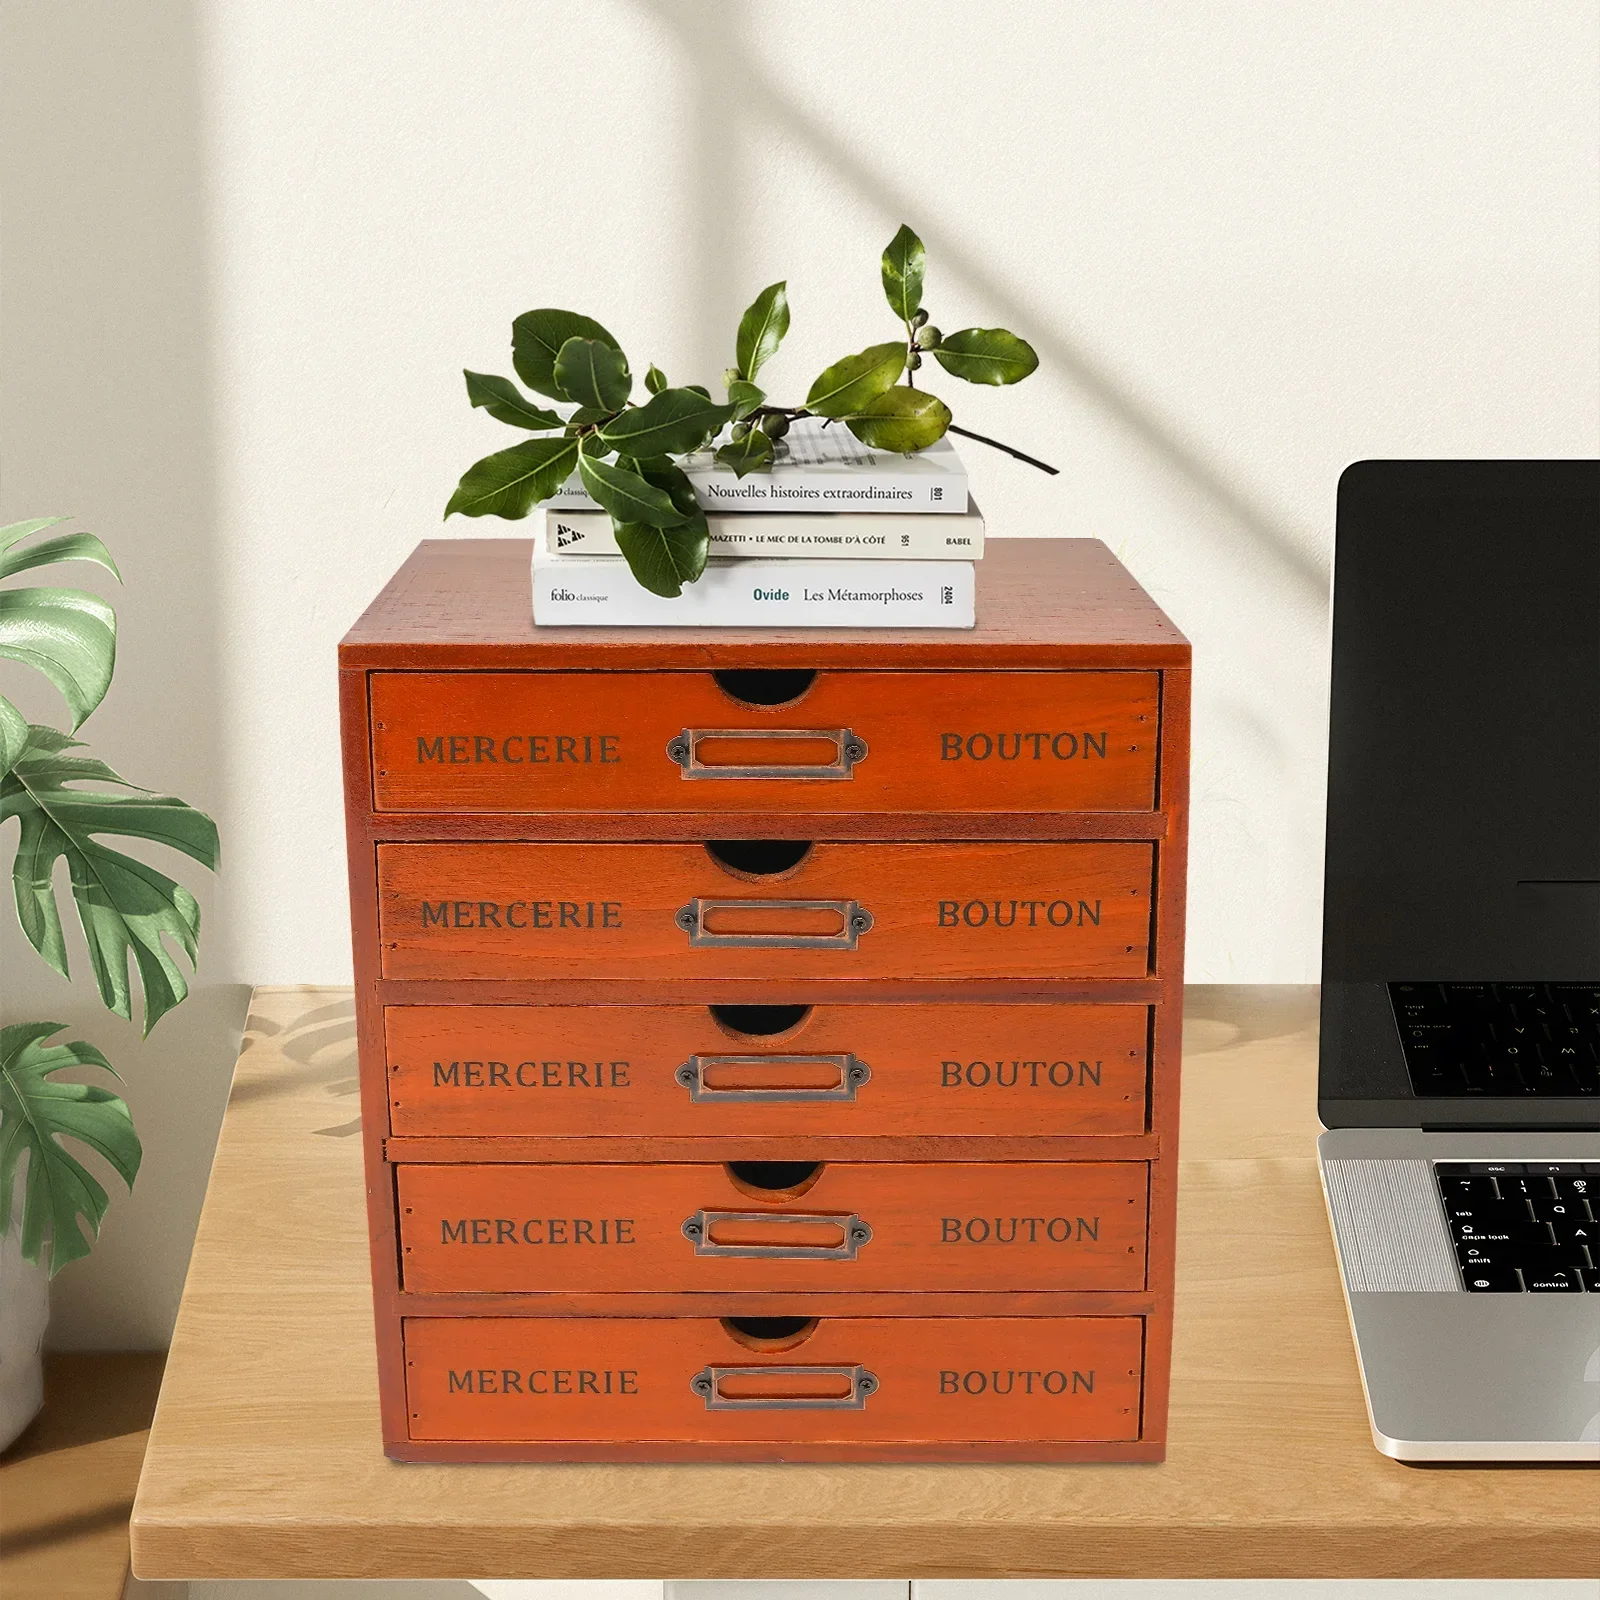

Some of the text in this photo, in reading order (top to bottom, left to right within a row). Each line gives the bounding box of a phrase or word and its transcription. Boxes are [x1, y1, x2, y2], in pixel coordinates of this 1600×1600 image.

[563, 487, 588, 498] classiq
[708, 485, 913, 500] Nouvelles histoires extraordinaires
[933, 486, 943, 501] 801
[755, 534, 764, 543] LE
[767, 535, 785, 544] MEC
[787, 535, 800, 544] DE
[801, 535, 812, 544] LA
[813, 536, 843, 544] TOMBE
[862, 534, 886, 545] CÔTÉ
[945, 537, 972, 546] BABEL
[550, 588, 609, 603] folio classique
[753, 588, 790, 601] Ovide
[803, 587, 924, 605] Les Métamorphoses
[943, 586, 953, 605] 2404
[418, 732, 1108, 764] MERCERIE BOUTON
[420, 900, 1101, 929] MERCERIE BOUTON
[434, 1061, 1103, 1088] MERCERIE BOUTON
[442, 1217, 1099, 1245] MERCERIE BOUTON
[1575, 1228, 1588, 1237] A
[449, 1370, 1094, 1395] MERCERIE BOUTON
